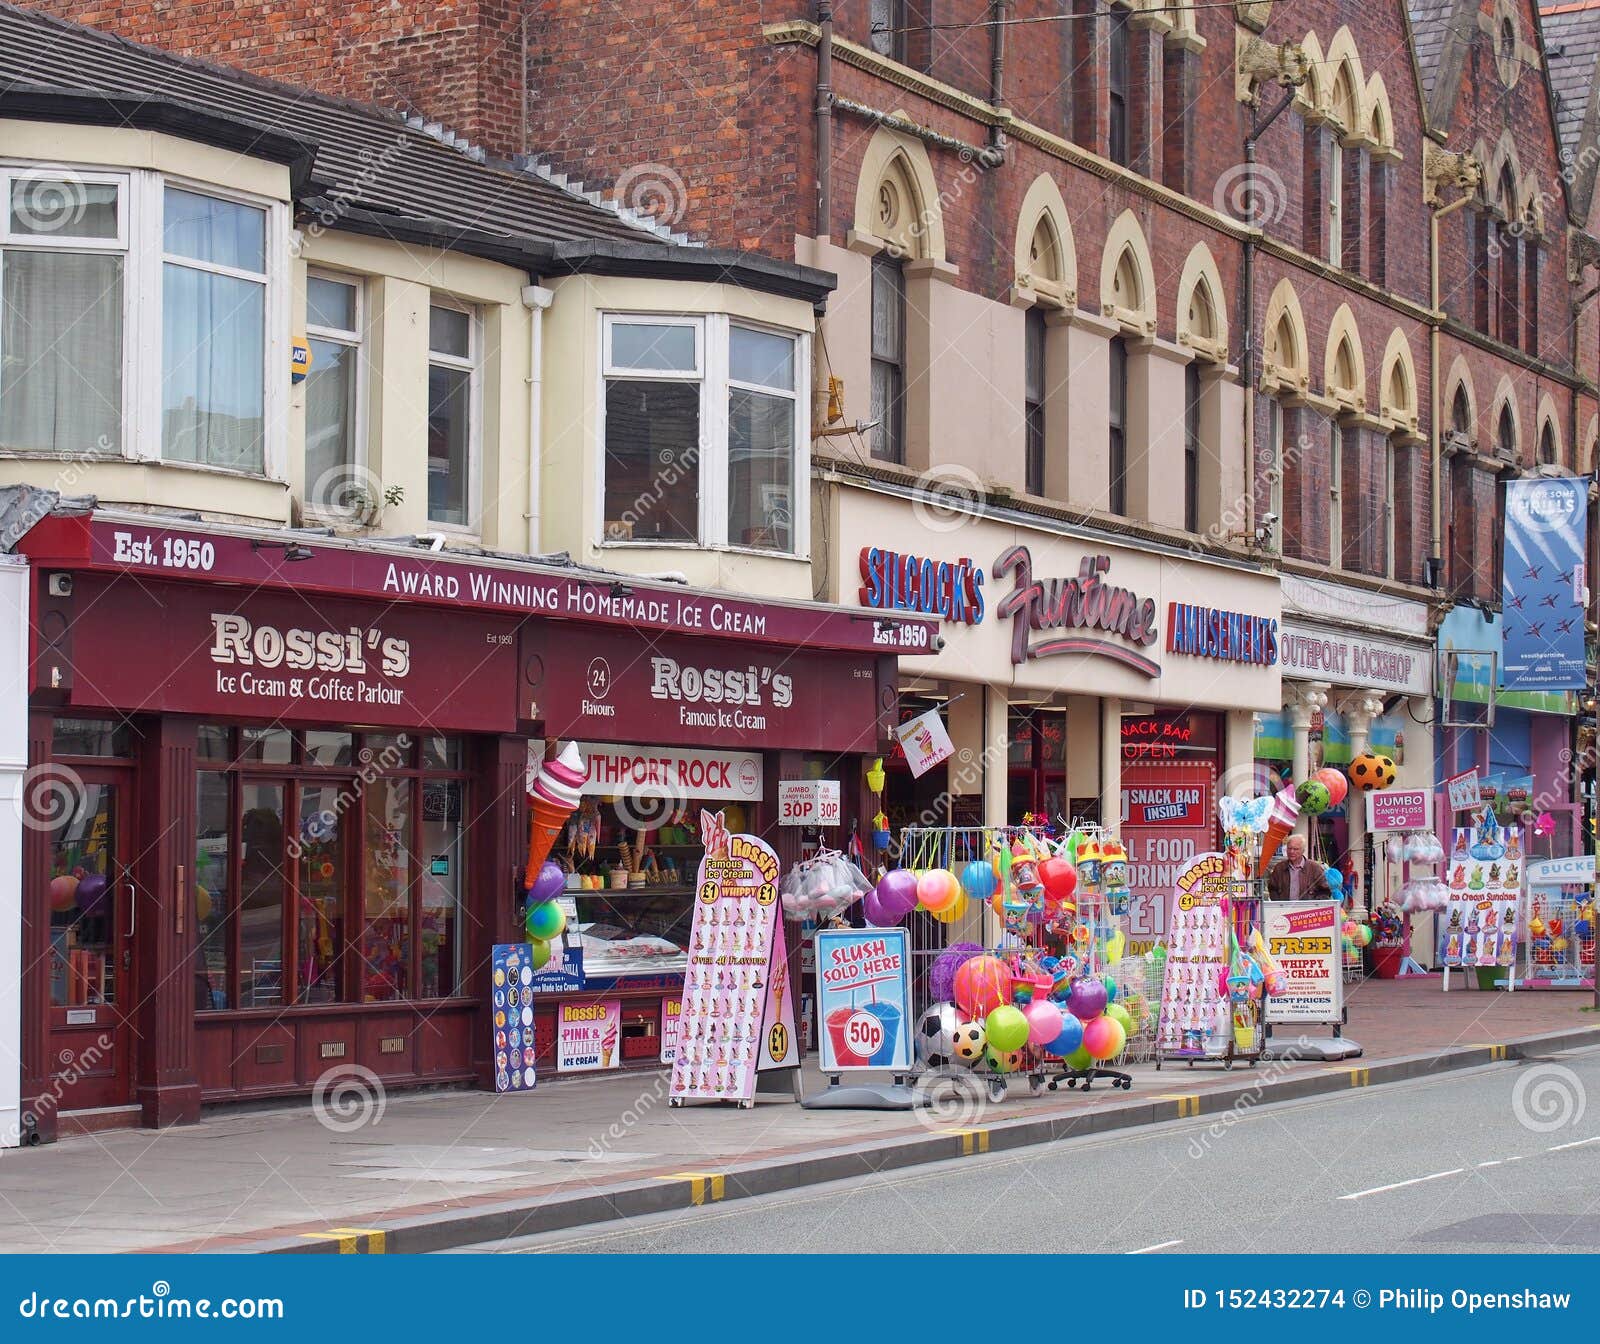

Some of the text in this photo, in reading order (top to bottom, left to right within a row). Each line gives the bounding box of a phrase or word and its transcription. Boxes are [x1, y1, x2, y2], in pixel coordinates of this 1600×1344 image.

[293, 348, 306, 362] ADT
[113, 531, 215, 571] Est. 1950
[859, 546, 985, 625] SILCOCK'S
[992, 545, 1158, 664] Funtime
[499, 633, 514, 646] 1950
[872, 621, 928, 648] Est. 1950
[1166, 601, 1279, 666] AMUSEMENTS
[1280, 632, 1413, 685] OUTHPORT ROCKSHOP
[592, 669, 607, 688] 24
[863, 669, 873, 680] 1950
[216, 669, 405, 706] Ice Cream & Coffee Parlour
[581, 699, 616, 717] Flavours
[679, 705, 767, 731] Famous Ice Cream
[1121, 721, 1192, 742] NACK BAR
[1123, 742, 1176, 759] OPEN
[583, 753, 732, 789] UTHPORT ROCK
[1130, 789, 1173, 805] SNACK
[1175, 788, 1200, 805] BAR
[1375, 795, 1423, 807] JUMBO
[783, 802, 813, 818] 30P
[821, 802, 838, 818] 30P
[1147, 803, 1185, 821] INSIDE
[1375, 806, 1423, 816] CANDY-FLOSS
[1146, 838, 1196, 862] FOOD
[705, 858, 743, 870] Famous
[1541, 860, 1595, 876] BUCKE
[705, 868, 754, 879] Ice Cream
[1202, 875, 1233, 884] Famou
[702, 883, 716, 899] £1
[720, 886, 759, 898] WHIPPY
[759, 885, 773, 901] £1
[1450, 893, 1460, 901] Ice
[1462, 893, 1486, 901] Cream
[1130, 894, 1166, 936] £1
[1289, 911, 1319, 922] SOUTHPORT
[830, 939, 887, 967] SLUSH
[1269, 936, 1333, 955] FREE
[715, 956, 728, 967] 40
[823, 955, 901, 984] SOLD HERE
[1280, 959, 1324, 969] WHIPPY
[1291, 969, 1330, 979] CREAM
[542, 983, 555, 992] Made
[564, 982, 580, 992] Cream
[563, 1004, 607, 1023] Rossi's
[562, 1027, 601, 1041] PINK &
[772, 1027, 784, 1052] £1
[850, 1021, 881, 1049] 50p
[563, 1040, 601, 1056] WHITE
[563, 1054, 599, 1067] ICE CREAM
